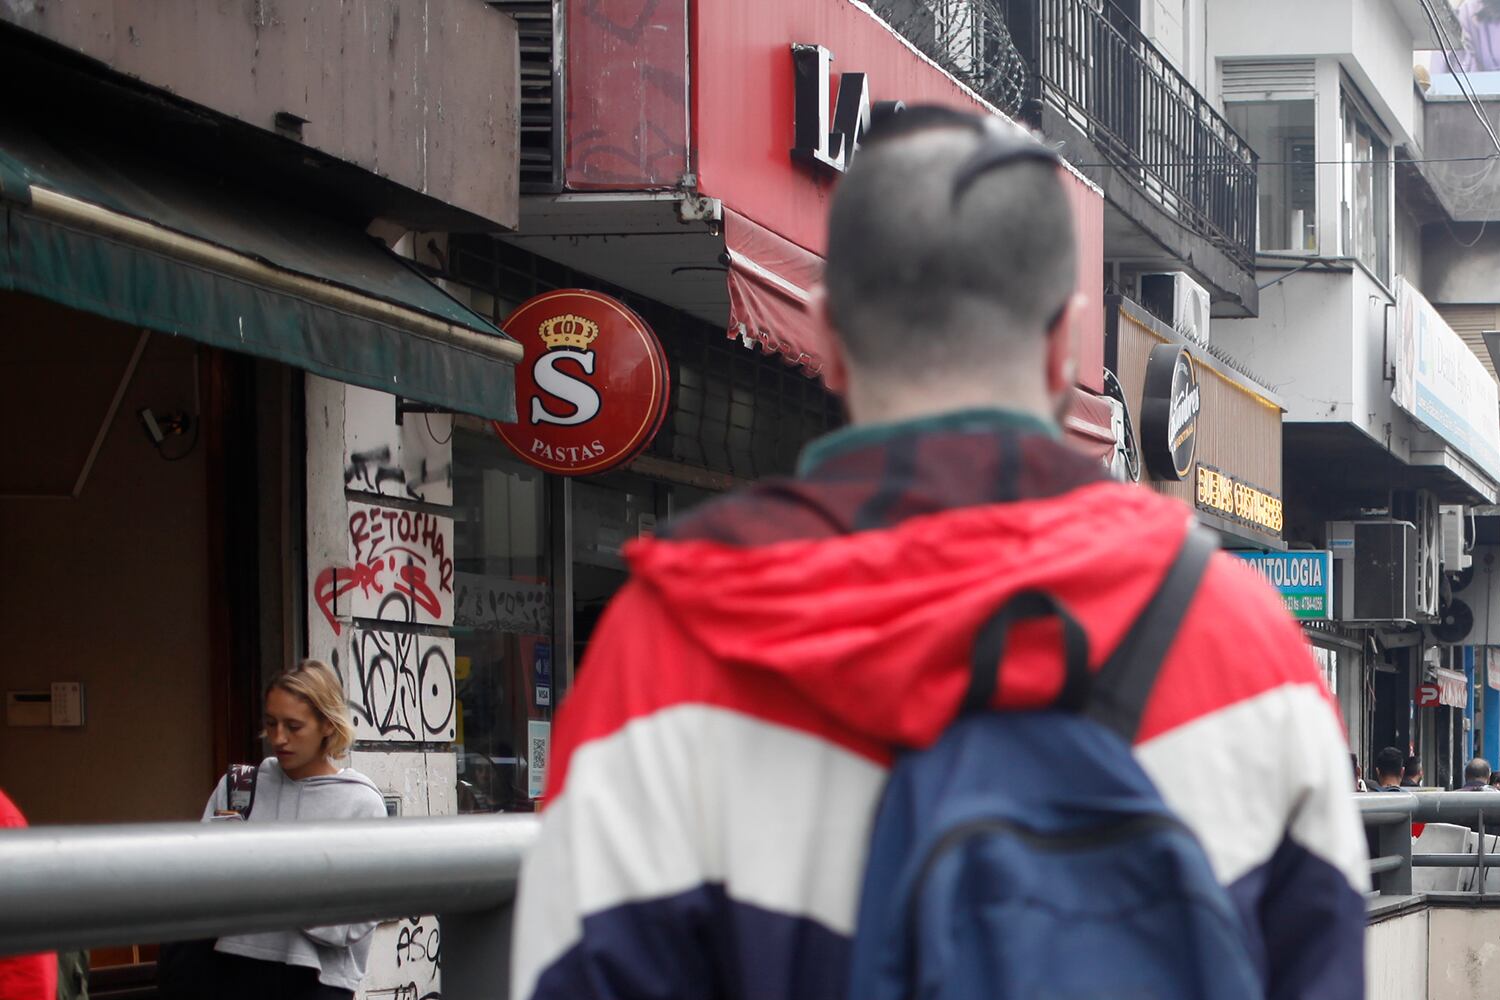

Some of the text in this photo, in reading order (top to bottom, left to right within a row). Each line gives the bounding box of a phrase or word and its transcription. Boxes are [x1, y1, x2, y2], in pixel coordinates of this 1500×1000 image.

[531, 350, 600, 427] S
[531, 438, 605, 462] PASTAS
[1198, 467, 1283, 531] BUENAS COSTUMBRES
